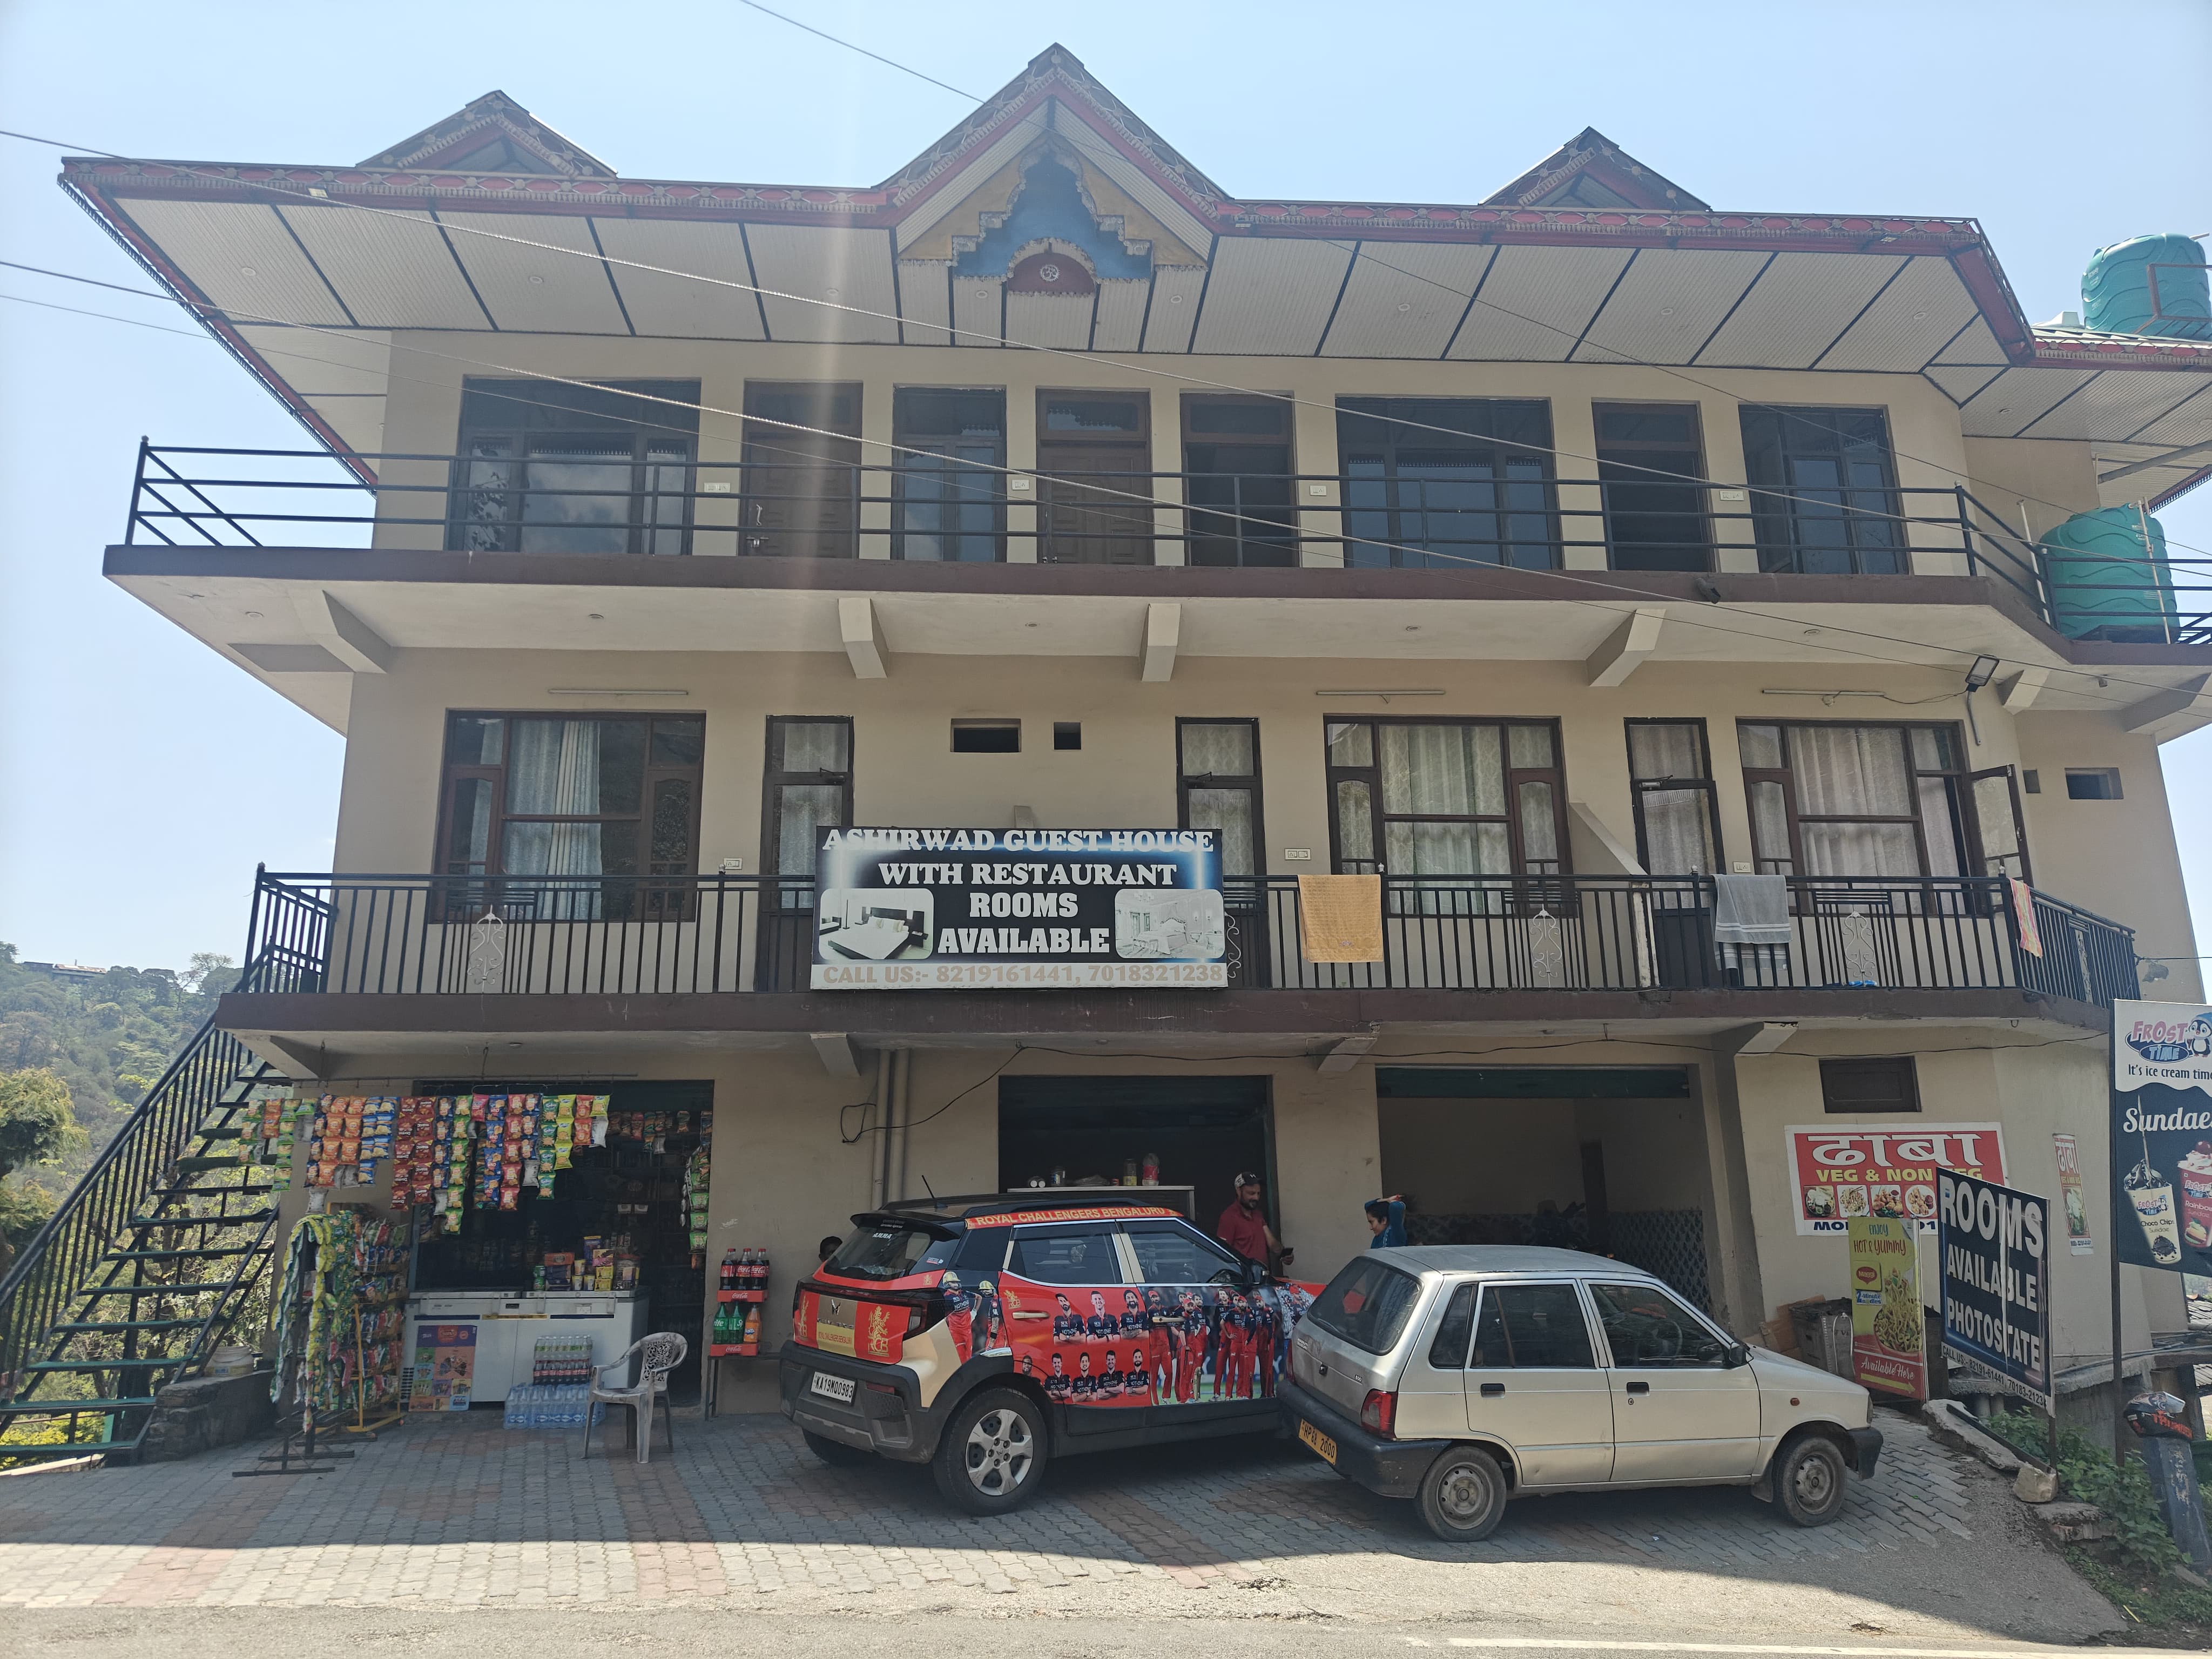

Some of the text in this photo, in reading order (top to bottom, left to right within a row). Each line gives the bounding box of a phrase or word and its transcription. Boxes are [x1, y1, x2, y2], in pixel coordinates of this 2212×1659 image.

[823, 830, 1213, 852] ASHIRWAD GUEST HOUSE
[879, 863, 1177, 885] WITH RESTAURANT
[969, 893, 1078, 918] ROOMS
[938, 928, 1110, 953] AVAILABLE
[824, 965, 1223, 985] CALL US:- 8219161441, 7018321238
[2132, 1021, 2189, 1043] FROST
[2128, 1064, 2142, 1075] It's
[2146, 1065, 2157, 1076] ice
[2161, 1069, 2189, 1078] cream
[2123, 1107, 2212, 1133] Sundae
[1816, 1168, 1984, 1182] VEG & NON EG
[977, 1207, 1165, 1225] ROYAL CHALLENGERS BENGALURU
[1813, 1222, 1848, 1230] MO
[1939, 1175, 2044, 1258] ROOMS
[1853, 1239, 1866, 1253] HOT
[1947, 1244, 2038, 1312] AVAILABLE
[954, 1299, 969, 1310] NOTHING
[868, 1336, 888, 1352] RCB
[1947, 1297, 2041, 1372] PHOTOSTATE
[1943, 1346, 1955, 1360] CALL
[1860, 1356, 1914, 1380] Available Here
[1320, 1438, 1335, 1459] 2000
